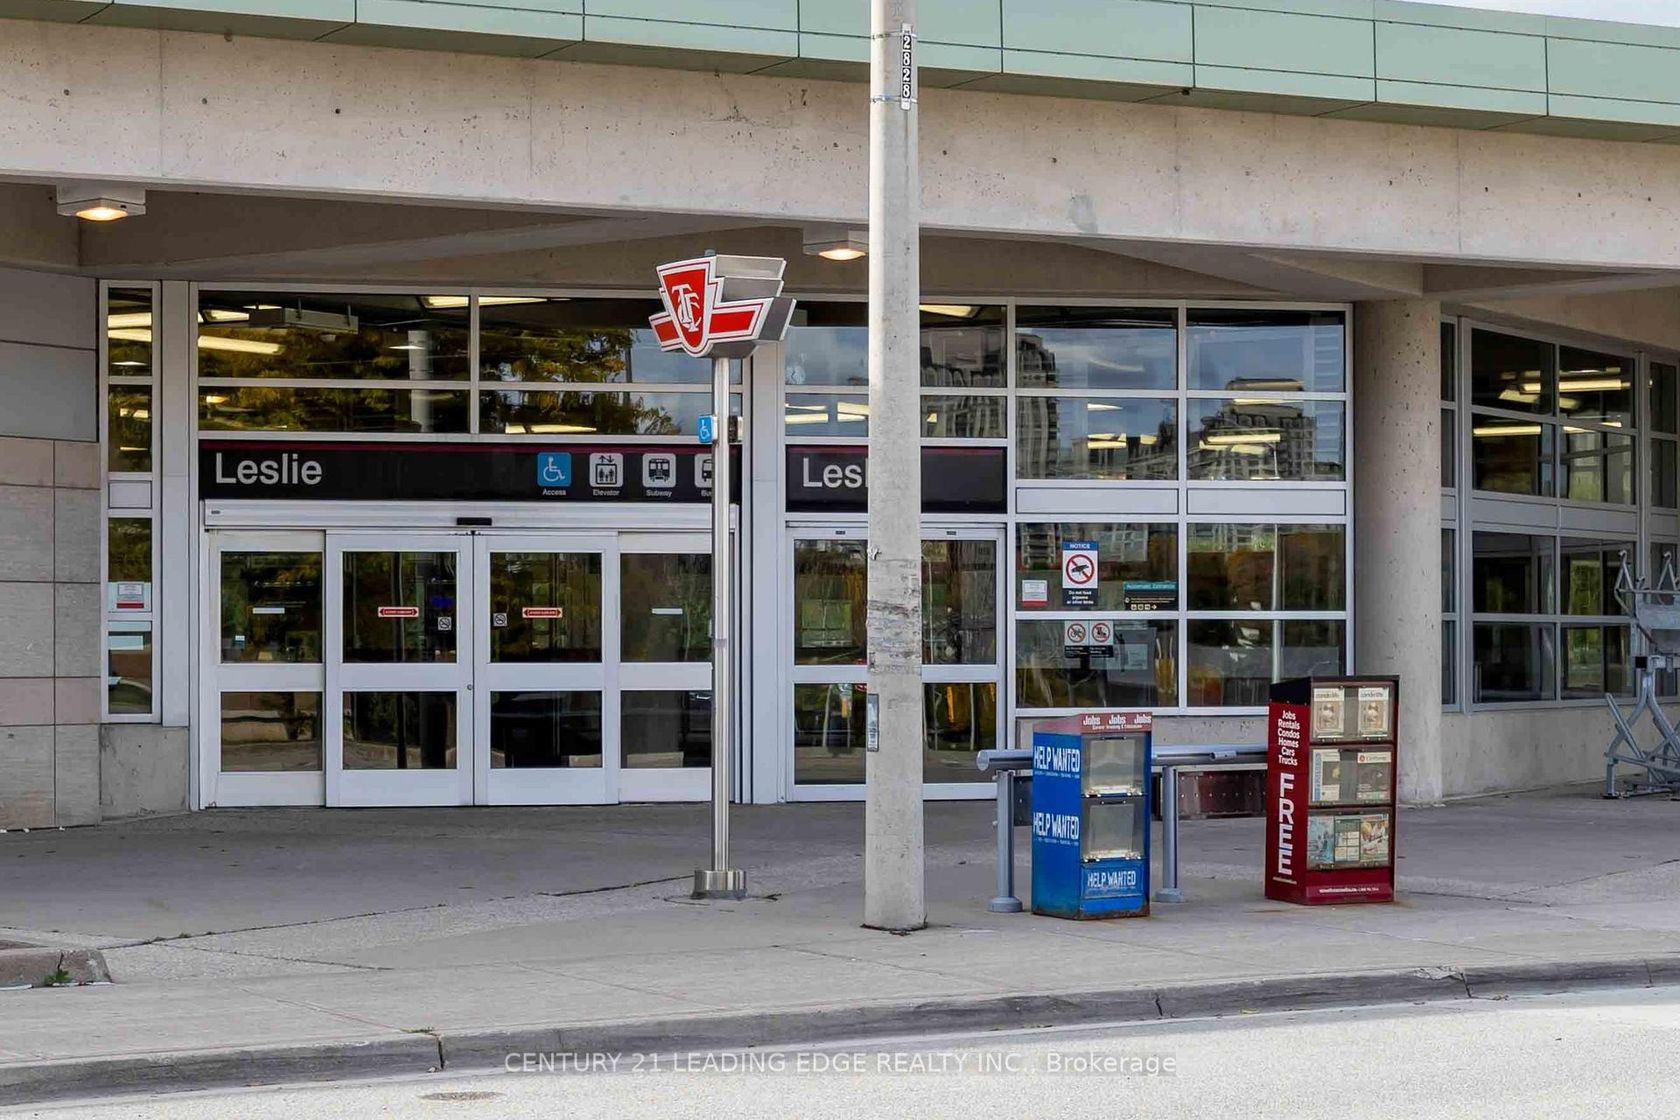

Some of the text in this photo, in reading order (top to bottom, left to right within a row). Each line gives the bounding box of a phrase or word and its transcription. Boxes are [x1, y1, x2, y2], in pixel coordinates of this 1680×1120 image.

[903, 35, 911, 98] 2828
[215, 452, 323, 485] Leslie
[542, 488, 567, 497] Access
[592, 489, 620, 497] Elevator
[646, 489, 673, 498] Subway
[1082, 714, 1152, 726] Jobs Jobs Jobs
[1282, 710, 1296, 720] Jobs
[1277, 719, 1300, 730] Rentals
[1277, 728, 1300, 739] Condos
[1278, 737, 1299, 748] Homes
[1281, 747, 1296, 757] Cars
[1033, 745, 1081, 773] HELP WANTED
[1278, 755, 1298, 766] Trucks
[1033, 811, 1080, 840] HELP WANTED
[1278, 772, 1295, 875] FREE
[1087, 870, 1137, 888] HELP WANTED
